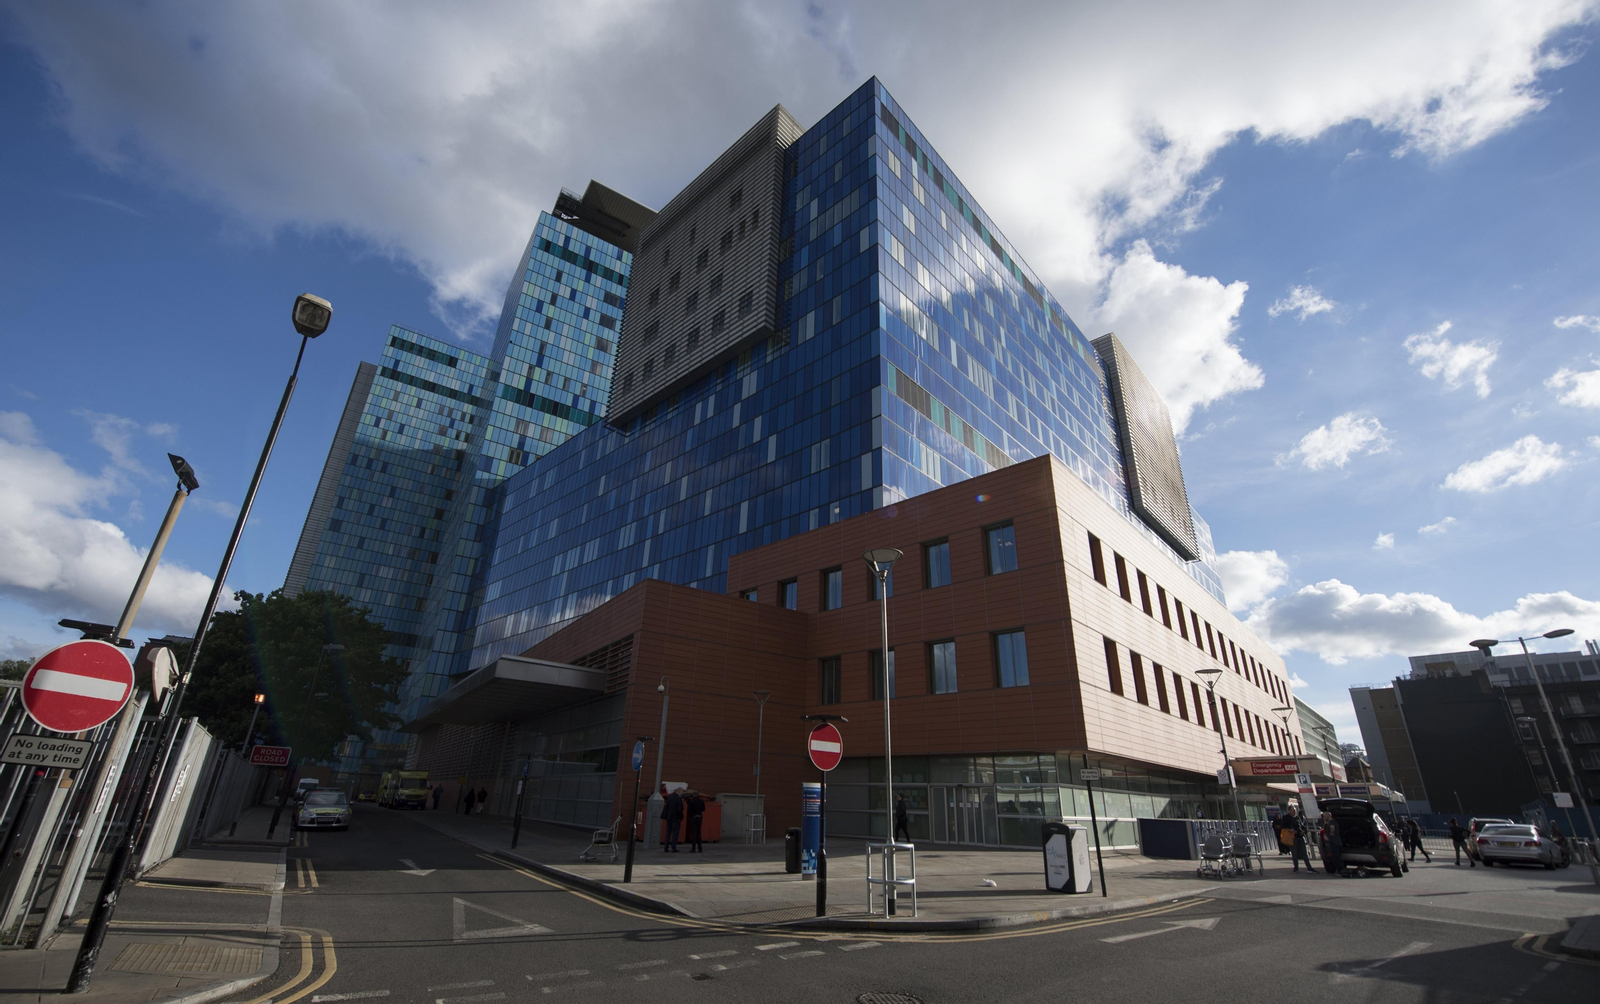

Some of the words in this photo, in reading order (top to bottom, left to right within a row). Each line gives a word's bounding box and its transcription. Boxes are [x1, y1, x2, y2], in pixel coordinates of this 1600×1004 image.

[14, 739, 33, 749] No
[37, 741, 83, 755] loading
[261, 748, 283, 756] ROAD
[8, 750, 22, 759] at
[25, 752, 49, 763] any
[52, 754, 80, 764] time
[253, 754, 286, 763] CLOSED
